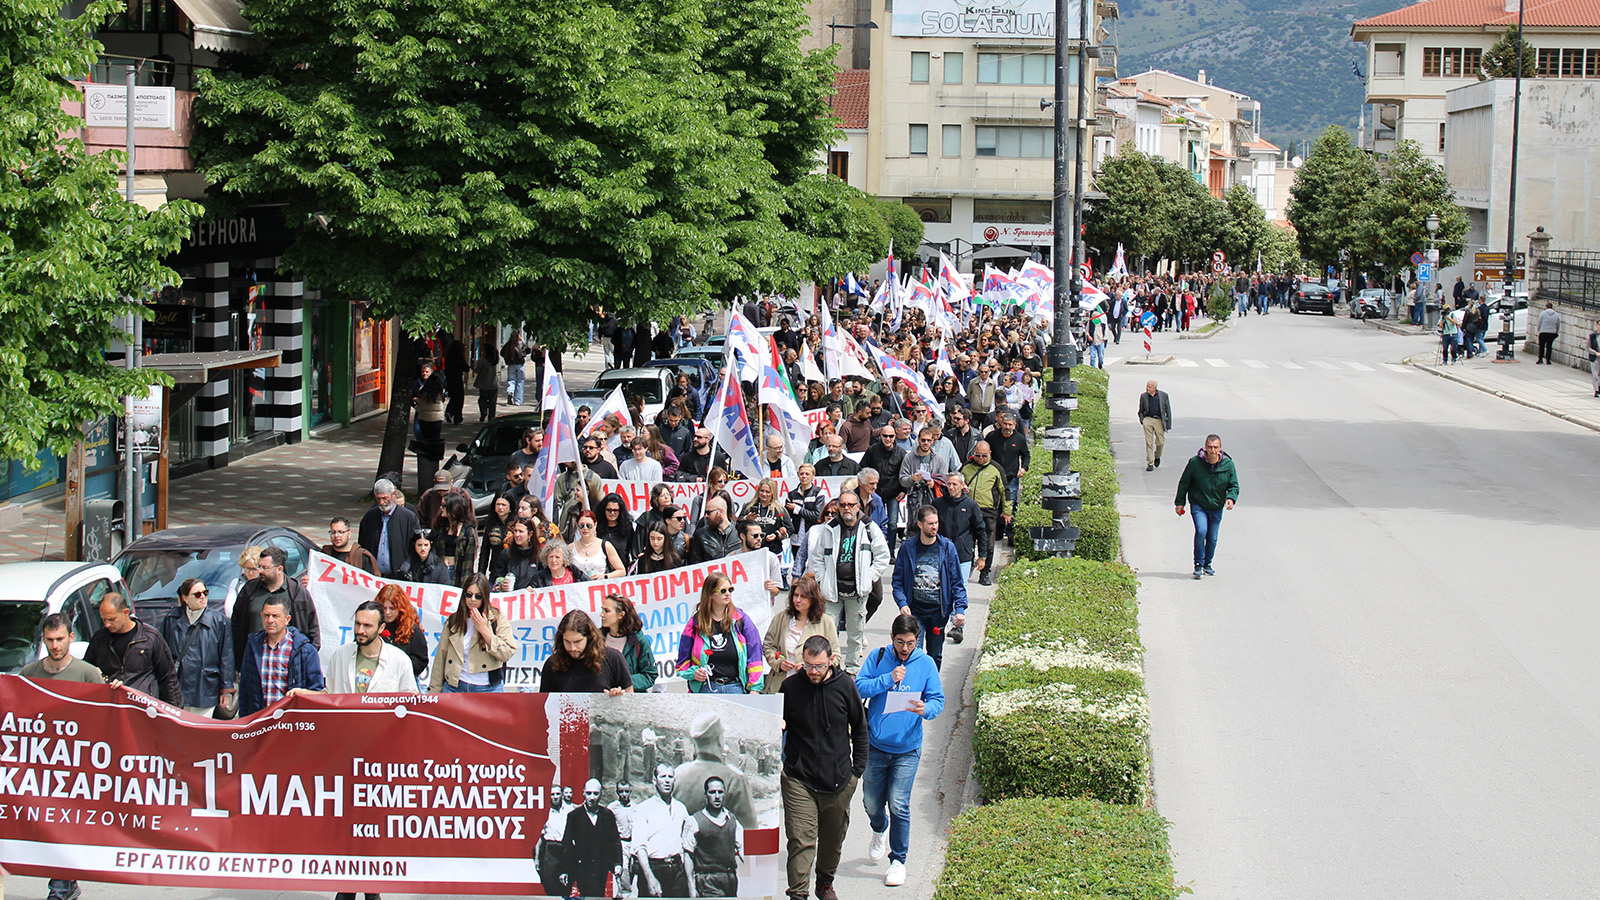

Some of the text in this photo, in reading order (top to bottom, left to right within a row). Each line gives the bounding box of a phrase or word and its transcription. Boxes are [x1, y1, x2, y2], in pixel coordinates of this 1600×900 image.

[921, 10, 1055, 37] SOLARIUM
[0, 712, 78, 737] Από το
[231, 721, 316, 740] Θεσσαλονίκη 1936
[0, 735, 175, 780] ΣΙΚΑΓΟ στην
[353, 758, 527, 784] Για μια ζωή χωρίς
[0, 766, 189, 806] ΚΑΙΣΑΡΙΑΝΗ
[240, 773, 344, 818] ΜΑΗ
[353, 783, 545, 810] ΕΚΜΕΤΑΛΛΕΥΣΗ
[0, 804, 162, 831] ΣΥΝΕΧΙΖΟΥΜΕ
[353, 815, 526, 840] και ΠΟΛΕΜΟΥΣ
[115, 851, 408, 877] ΕΡΓΑΤΙΚΟ ΚΕΝΤΡΟ ΙΩΑΝΝΙΝΩΝ
